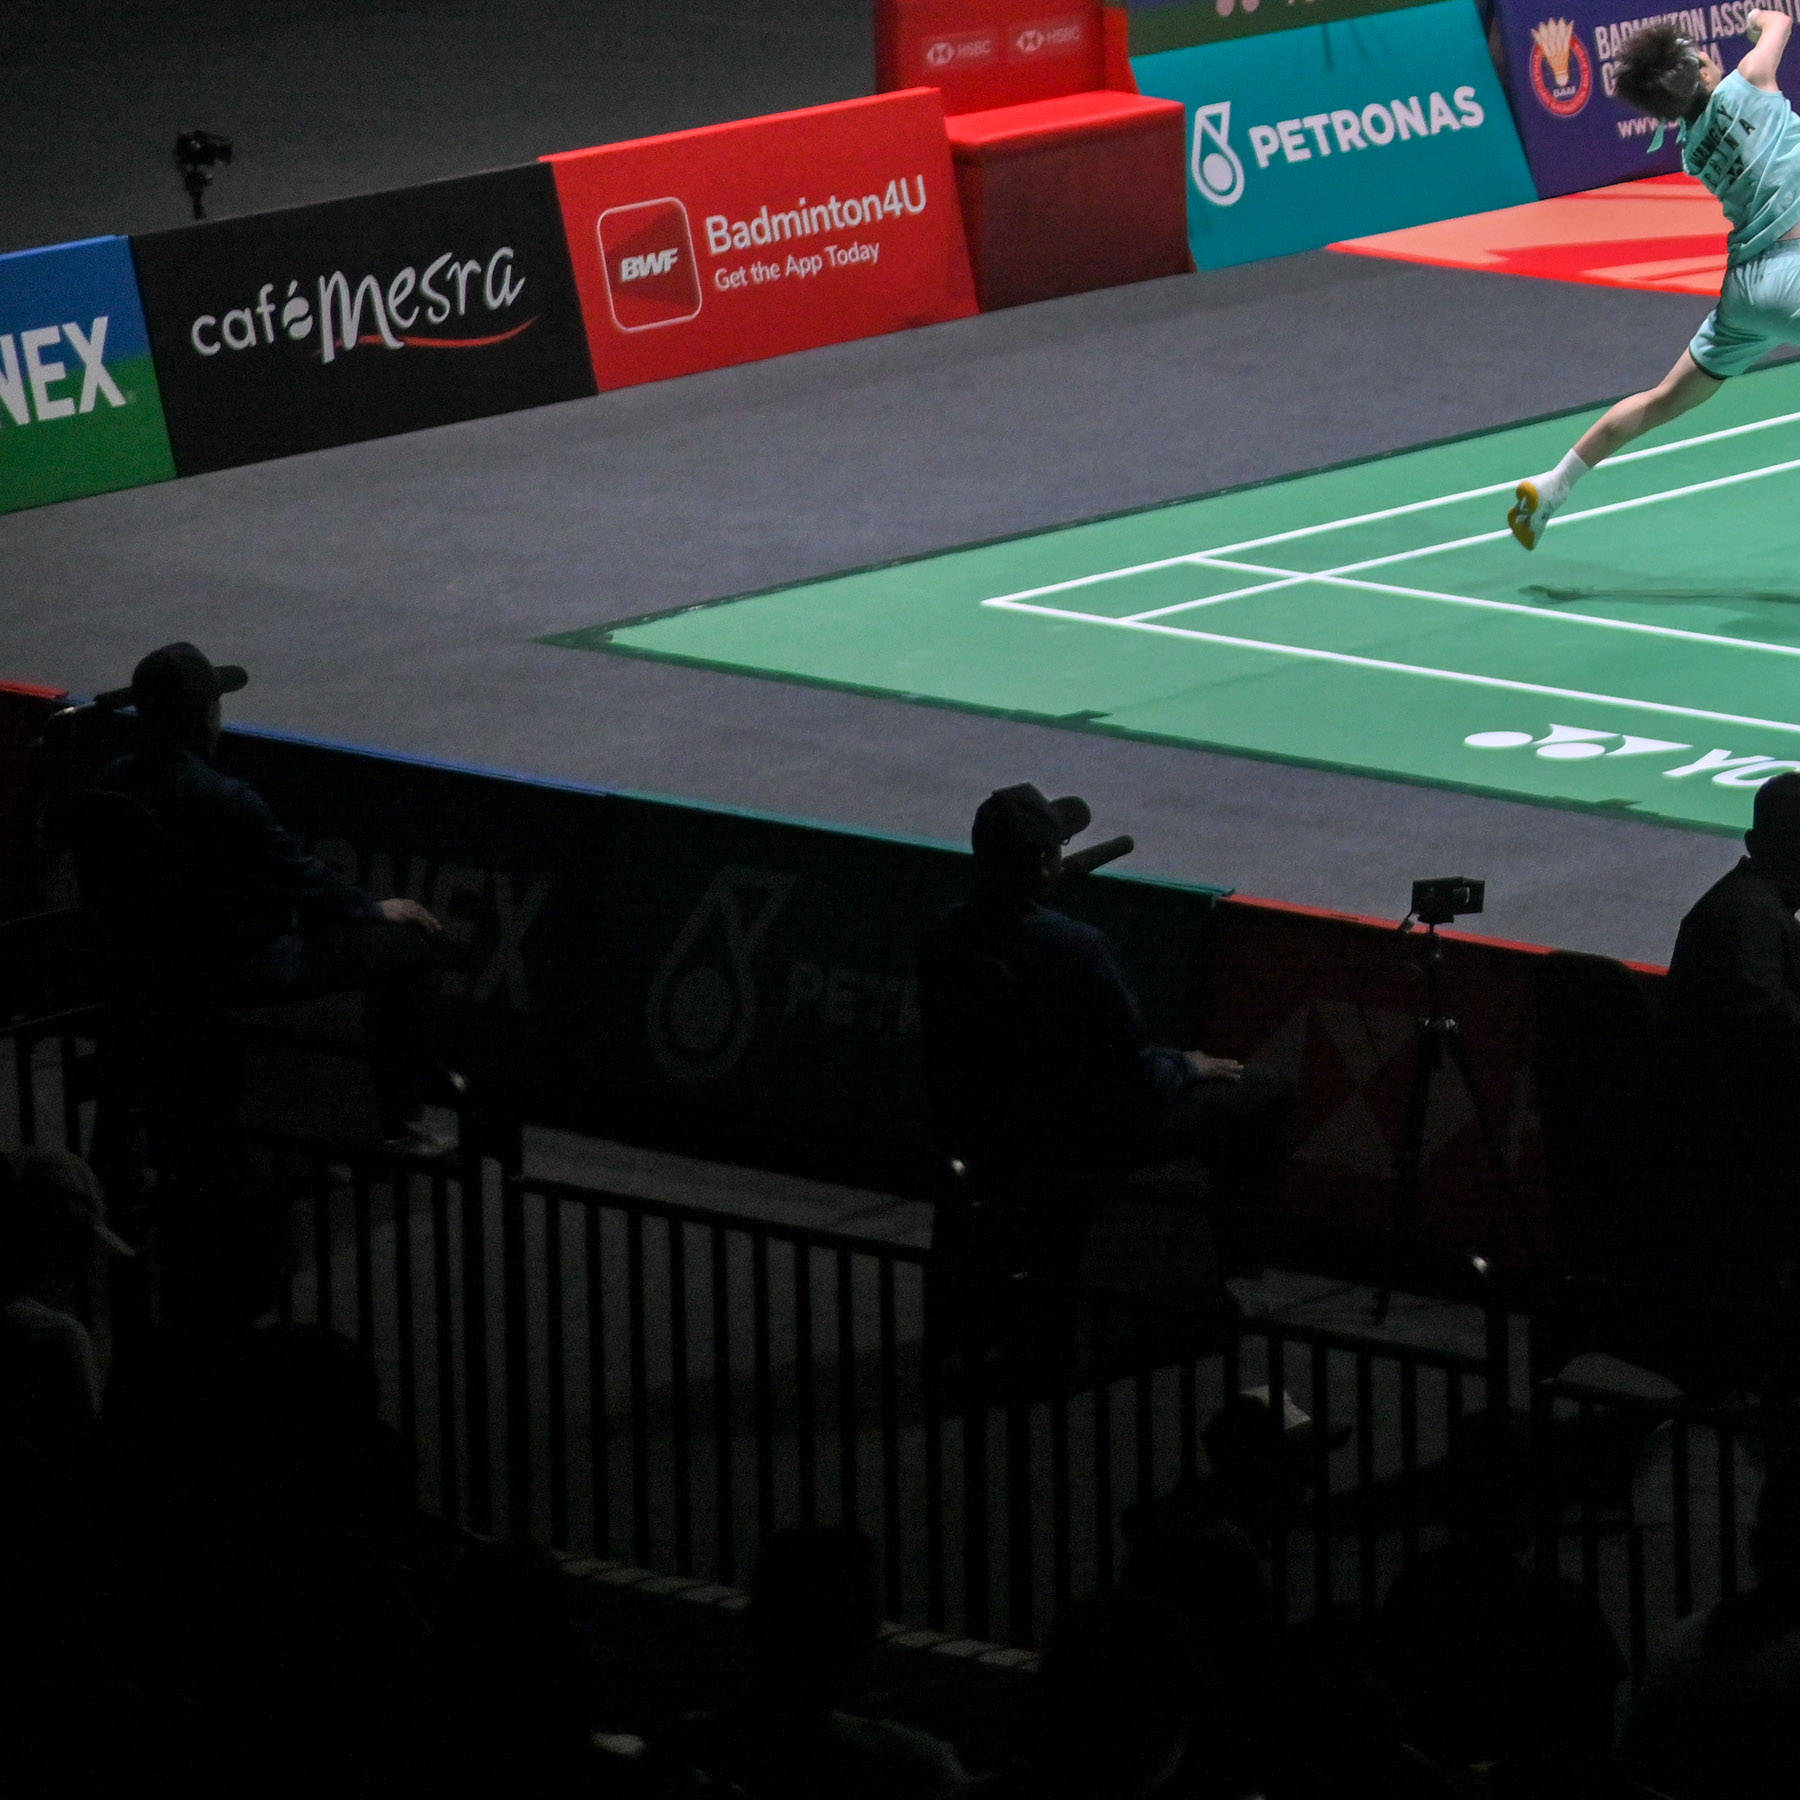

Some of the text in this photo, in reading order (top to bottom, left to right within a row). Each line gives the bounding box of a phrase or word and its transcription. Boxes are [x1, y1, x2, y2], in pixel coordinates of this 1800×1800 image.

[1247, 84, 1487, 170] PETRONAS
[705, 173, 928, 257] Badminton4U
[620, 247, 679, 283] BWF
[714, 241, 880, 292] Get the App Today
